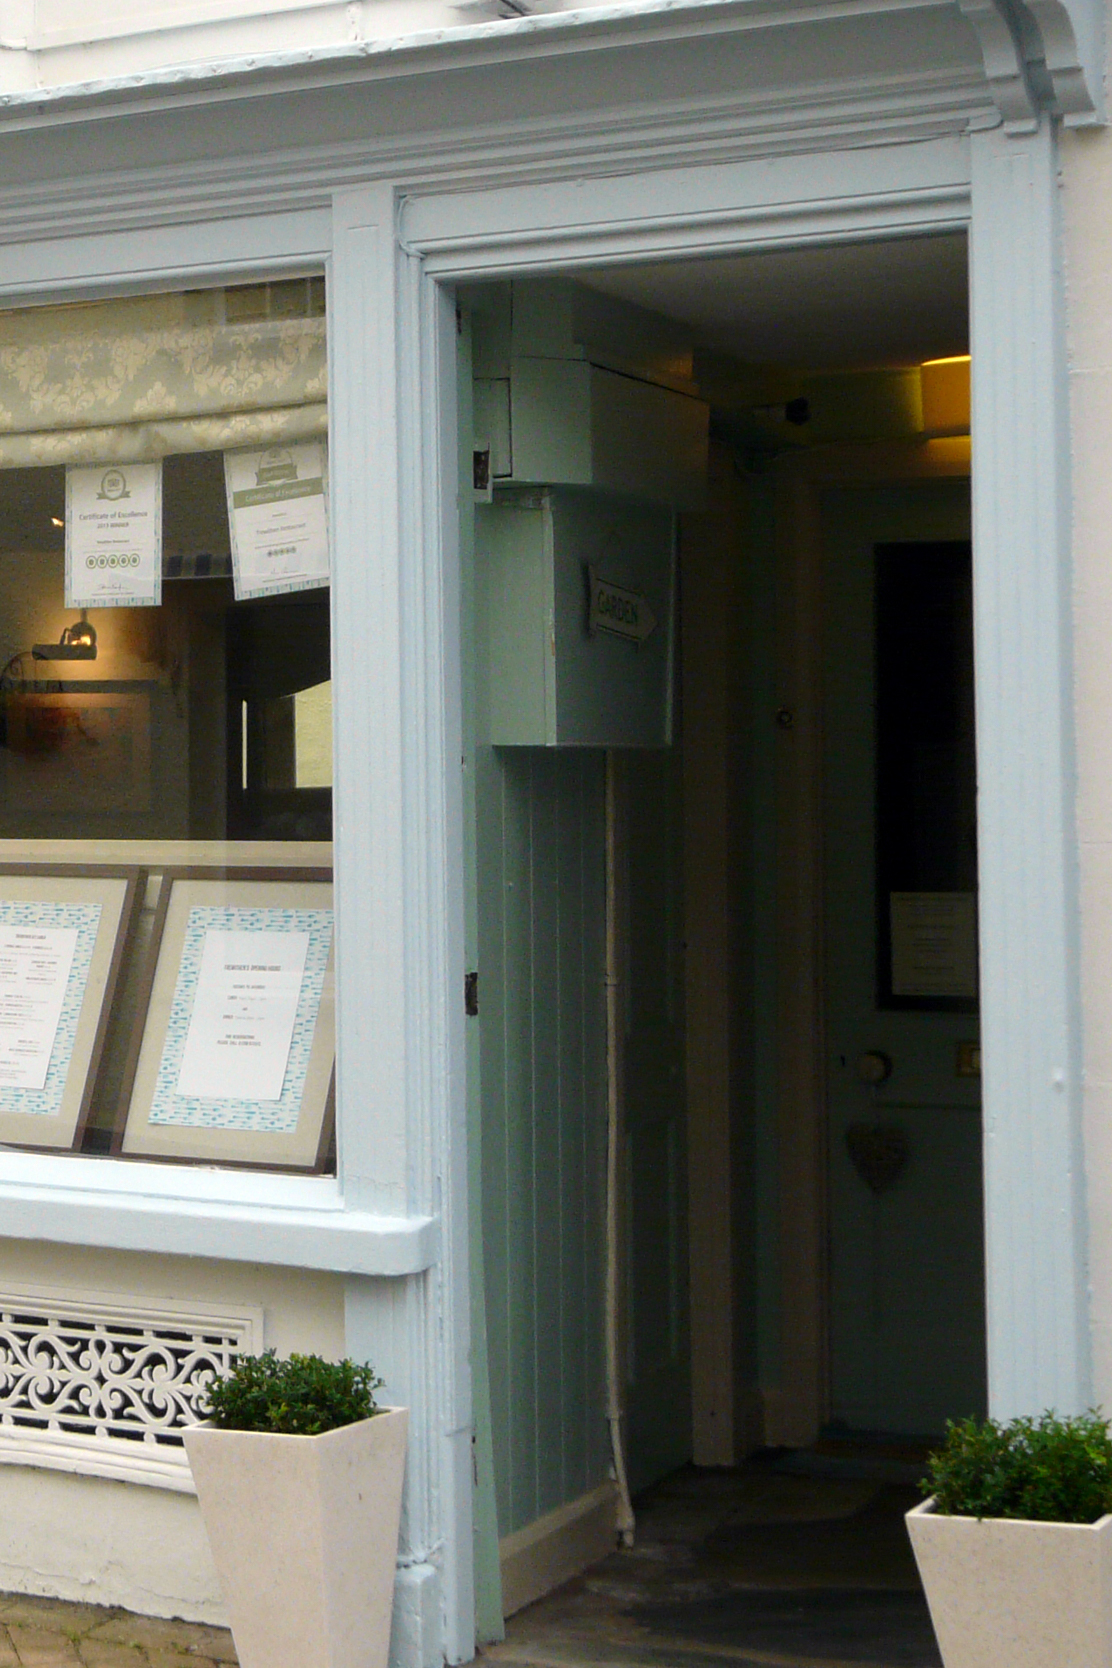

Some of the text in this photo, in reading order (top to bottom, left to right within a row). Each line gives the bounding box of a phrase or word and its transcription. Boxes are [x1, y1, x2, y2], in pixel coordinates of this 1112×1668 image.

[79, 510, 148, 520] Certificate of Excellence
[598, 589, 638, 627] GARDEN
